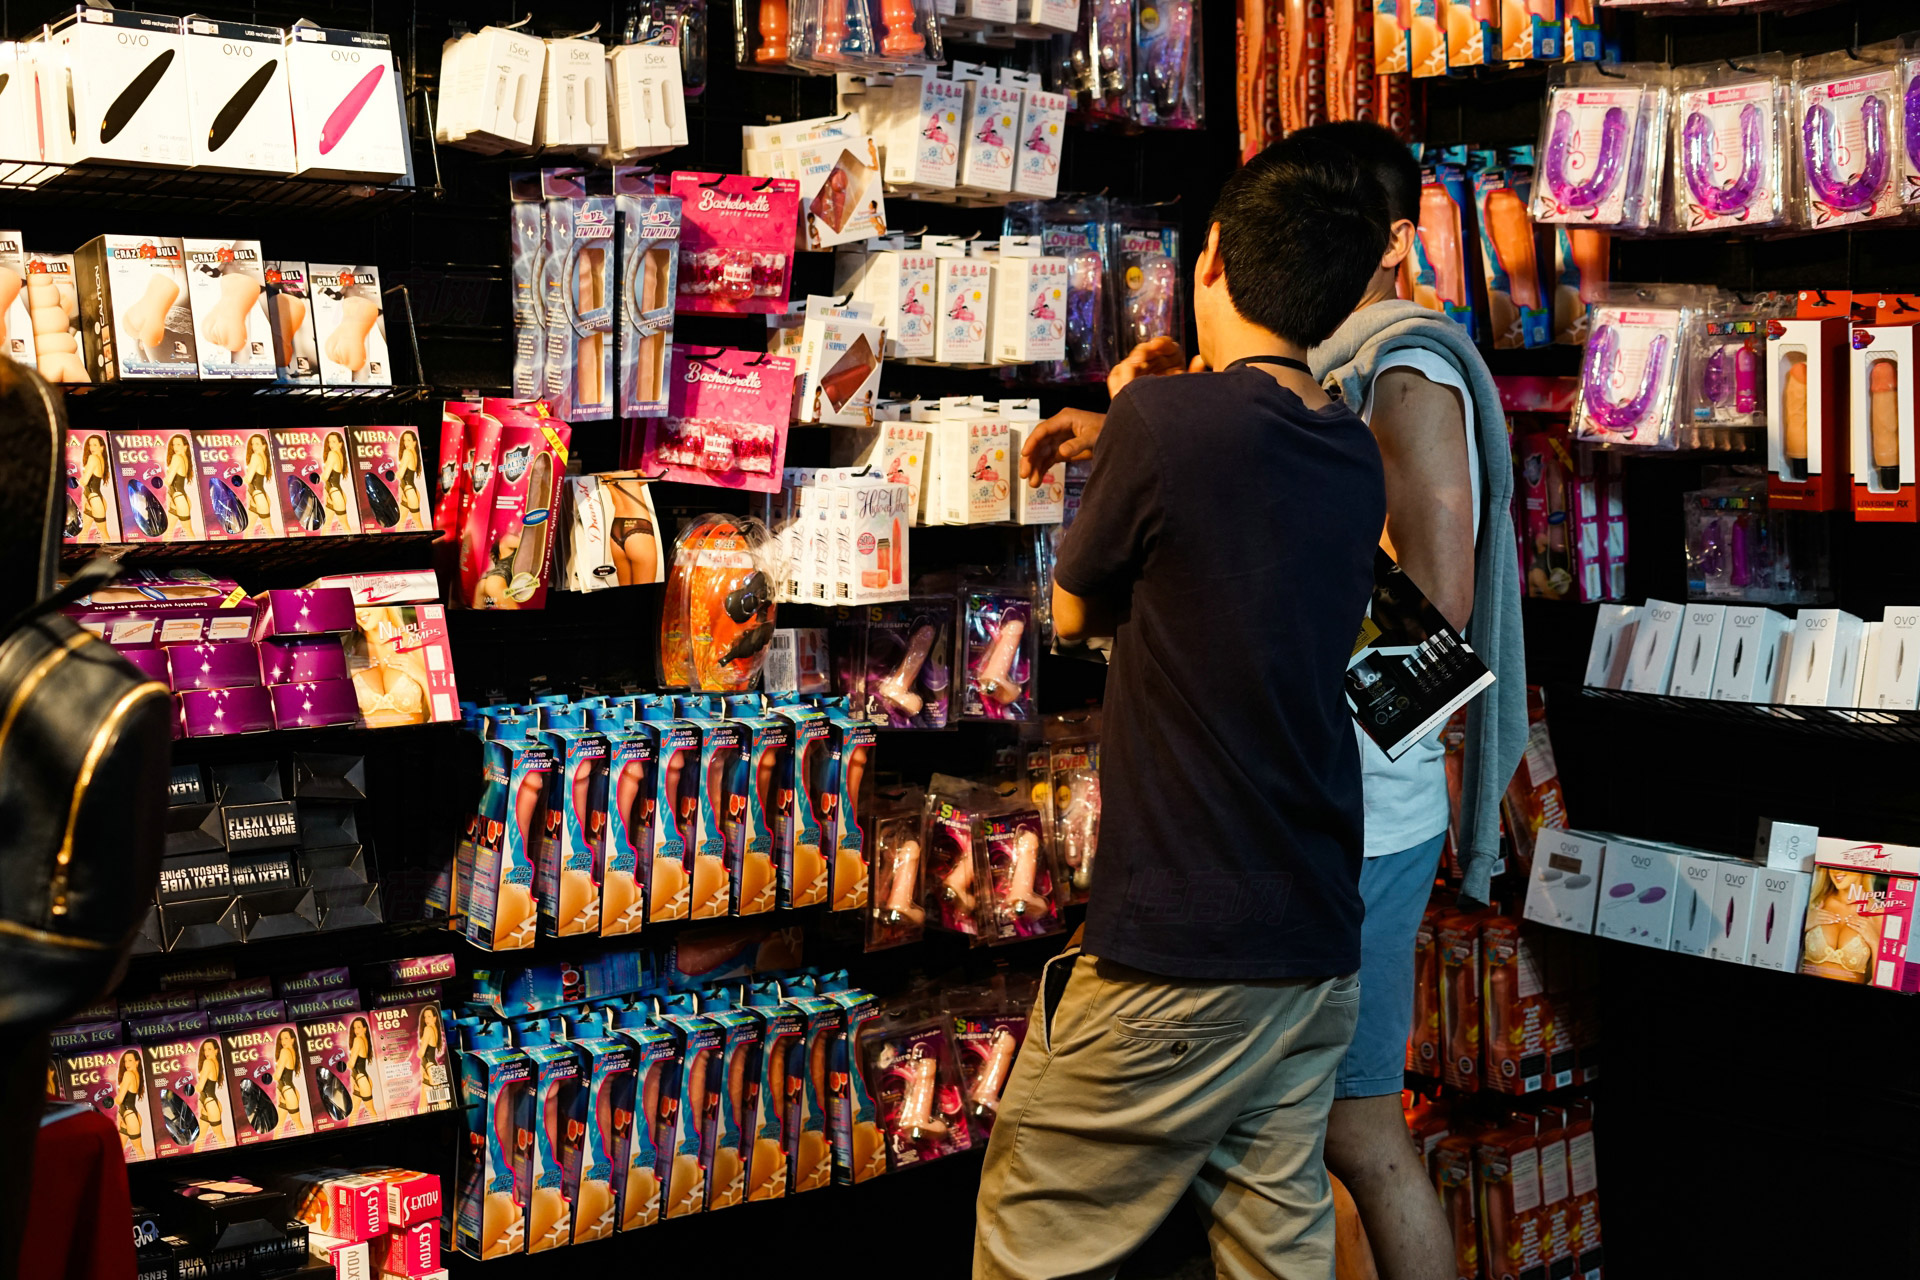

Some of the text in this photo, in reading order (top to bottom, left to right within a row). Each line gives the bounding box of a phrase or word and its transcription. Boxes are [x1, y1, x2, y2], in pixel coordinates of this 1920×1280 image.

[117, 32, 149, 47] OVO
[223, 43, 253, 58] OVO
[331, 50, 361, 63] OVO
[509, 41, 529, 58] iSex
[570, 49, 590, 61] iSex
[644, 53, 665, 64] iSex
[1834, 82, 1860, 94] Double
[698, 189, 770, 213] Bachelorette
[720, 210, 741, 218] party
[575, 226, 613, 238] COMPANION
[641, 226, 680, 238] COMPANION
[1046, 234, 1086, 246] LOVER
[1122, 239, 1161, 251] LOVER
[156, 246, 178, 258] BULL
[233, 249, 255, 260] BULL
[46, 262, 68, 273] BULL
[281, 270, 302, 281] BULL
[354, 273, 374, 284] BULL
[95, 265, 105, 327] CAUTION
[684, 362, 762, 388] Bachelorette
[115, 434, 165, 448] VIBRA
[196, 434, 244, 448] VIBRA
[275, 432, 321, 446] VIBRA
[354, 430, 397, 444] VIBRA
[548, 433, 565, 454] NEW
[118, 449, 149, 463] EGG
[199, 449, 229, 463] EGG
[279, 447, 307, 461] EGG
[357, 445, 383, 458] EGG
[509, 451, 523, 459] THE
[1804, 489, 1815, 497] RX
[1896, 499, 1908, 508] RX
[1651, 608, 1672, 620] OVO
[1692, 612, 1714, 623] OVO
[1734, 615, 1756, 626] OVO
[1894, 615, 1916, 626] OVO
[378, 621, 428, 639] NIPPLE
[1805, 618, 1828, 628] OVO
[1052, 755, 1086, 770] LOVER
[228, 812, 296, 831] FLEXI VIBE
[229, 825, 297, 840] SENSUAL SPINE
[1560, 842, 1580, 854] OVO
[1790, 835, 1800, 861] OVO
[254, 861, 289, 873] SENSUAL
[1631, 854, 1651, 867] OVO
[159, 863, 230, 881] SENSUAL SPINE
[259, 869, 290, 882] FLEXI
[1687, 866, 1709, 879] OVO
[161, 873, 231, 894] FLEXI VIBE
[1724, 873, 1746, 886] OVO
[1765, 878, 1786, 891] OVO
[1848, 883, 1896, 901] NIPPLE
[396, 963, 451, 979] VIBRA EGG
[284, 975, 345, 991] VIBRA EGG
[204, 985, 266, 1002] VIBRA EGG
[380, 987, 436, 1002] VIBRA EGG
[126, 997, 190, 1013] VIBRA EGG
[292, 998, 354, 1014] VIBRA EGG
[215, 1008, 279, 1025] VIBRA EGG
[374, 1008, 409, 1021] VIBRA
[136, 1019, 202, 1036] VIBRA EGG
[303, 1020, 347, 1039] VIBRA
[377, 1020, 401, 1031] EGG
[50, 1029, 116, 1048] VIBRA EGG
[227, 1031, 273, 1050] VIBRA
[955, 1032, 992, 1040] Pleasure
[148, 1042, 196, 1060] VIBRA
[306, 1037, 334, 1052] EGG
[68, 1053, 117, 1070] VIBRA
[231, 1047, 259, 1064] EGG
[151, 1059, 181, 1076] EGG
[70, 1070, 100, 1087] EGG
[360, 1186, 380, 1233] SEXTOY
[403, 1190, 438, 1222] SEXTOY
[281, 1236, 306, 1250] VIBE
[412, 1222, 433, 1268] SEXTOY
